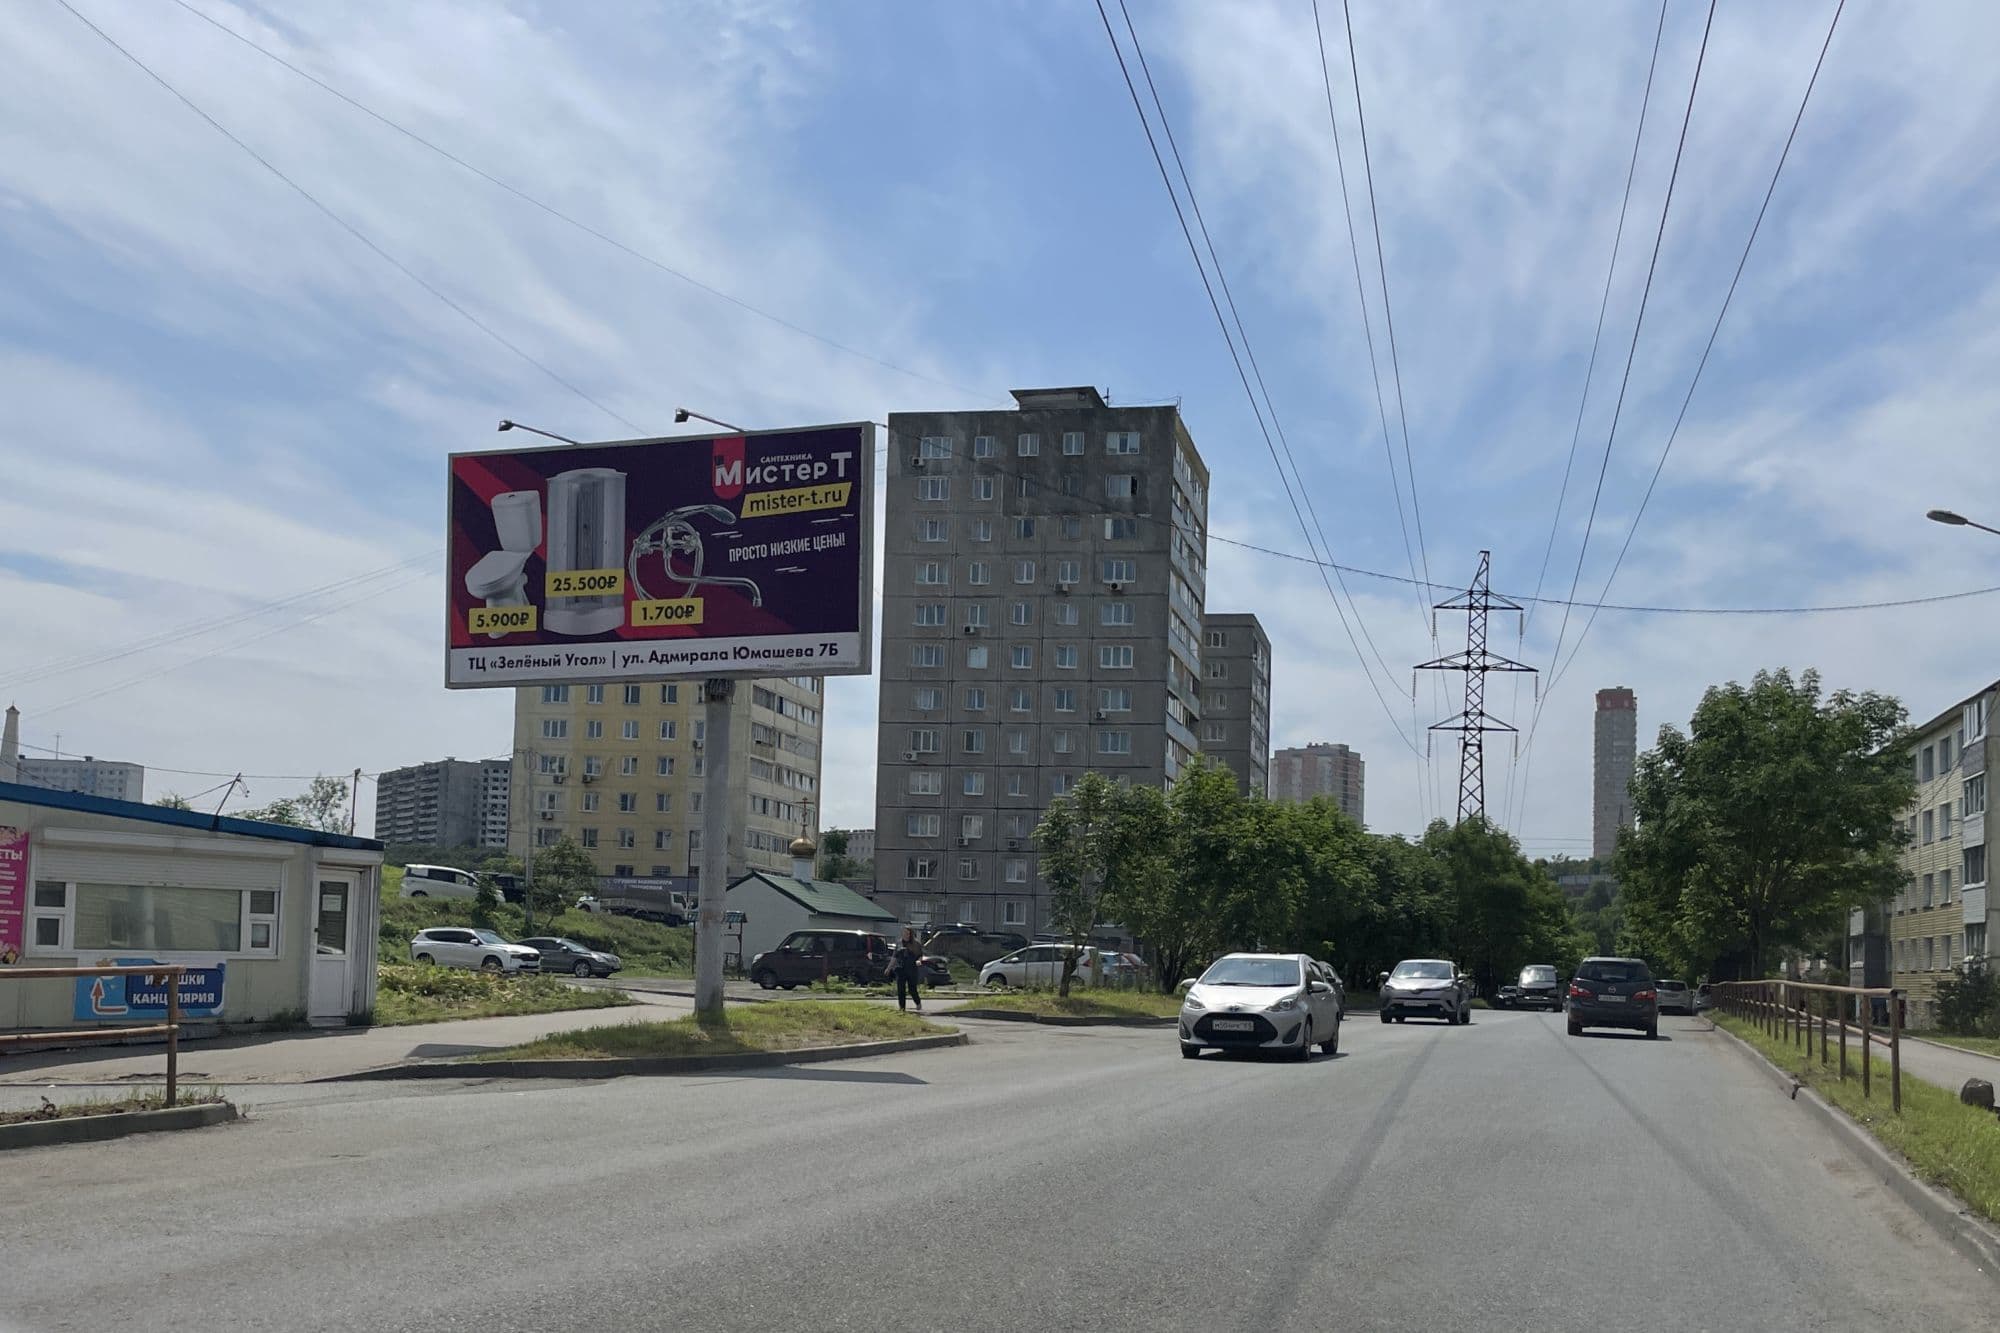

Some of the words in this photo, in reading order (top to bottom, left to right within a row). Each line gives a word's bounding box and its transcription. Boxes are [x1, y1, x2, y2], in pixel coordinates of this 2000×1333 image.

[760, 453, 812, 464] САНТЕХНИКА
[750, 489, 842, 512] mister-t.ru
[729, 544, 767, 562] ПРОСТО
[770, 537, 811, 556] НИЗКИЕ
[813, 532, 846, 552] ЦЕНЫ!
[468, 657, 487, 672] ТЦ
[490, 654, 561, 670] «Зелёный
[565, 653, 606, 668] Угол»
[622, 652, 644, 667] ул.
[648, 648, 729, 666] Адмирала
[733, 644, 814, 660] Юмашева
[818, 643, 839, 657] 7Б
[132, 992, 215, 1006] КАНЦЛЯРИЯ
